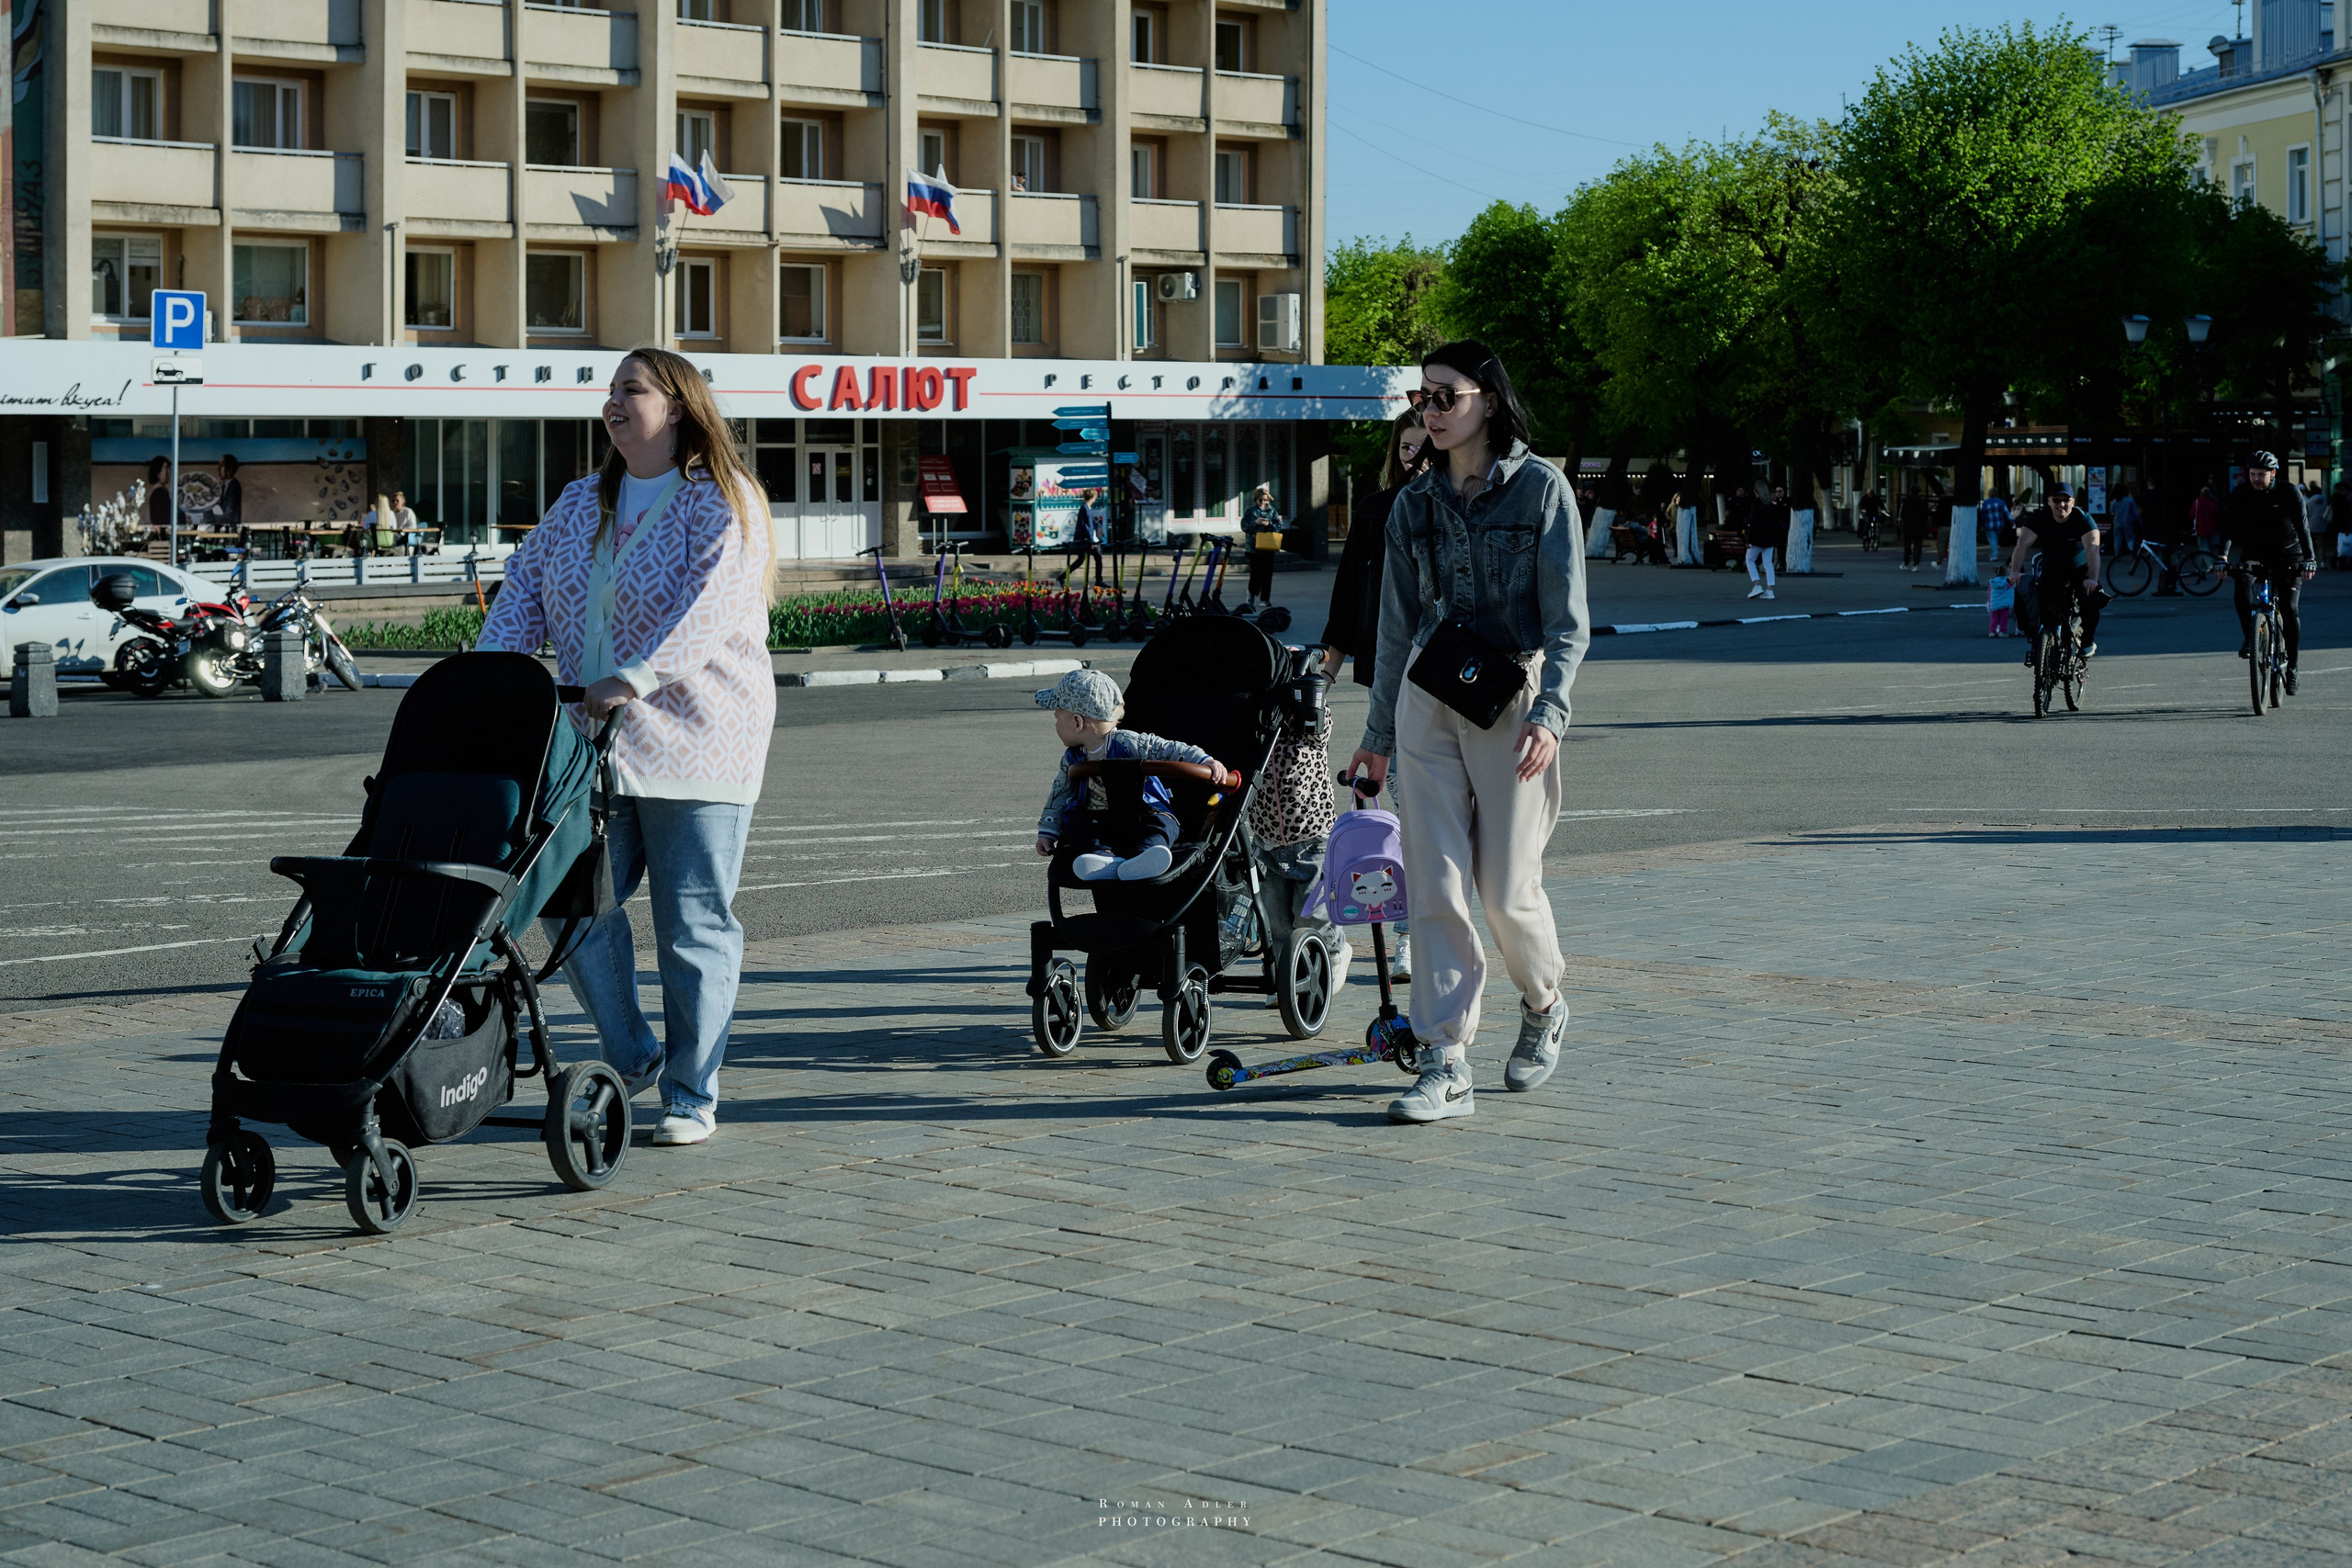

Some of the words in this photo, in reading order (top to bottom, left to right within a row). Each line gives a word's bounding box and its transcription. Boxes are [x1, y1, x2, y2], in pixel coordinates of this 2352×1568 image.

[165, 297, 195, 344] P
[362, 362, 714, 383] ГОСТИНА
[790, 364, 978, 412] САЛЮТ
[1044, 373, 1304, 392] РЕСТОРАН
[350, 988, 385, 998] EPICA
[536, 997, 546, 1026] Indigo
[441, 1066, 488, 1108] Indigo
